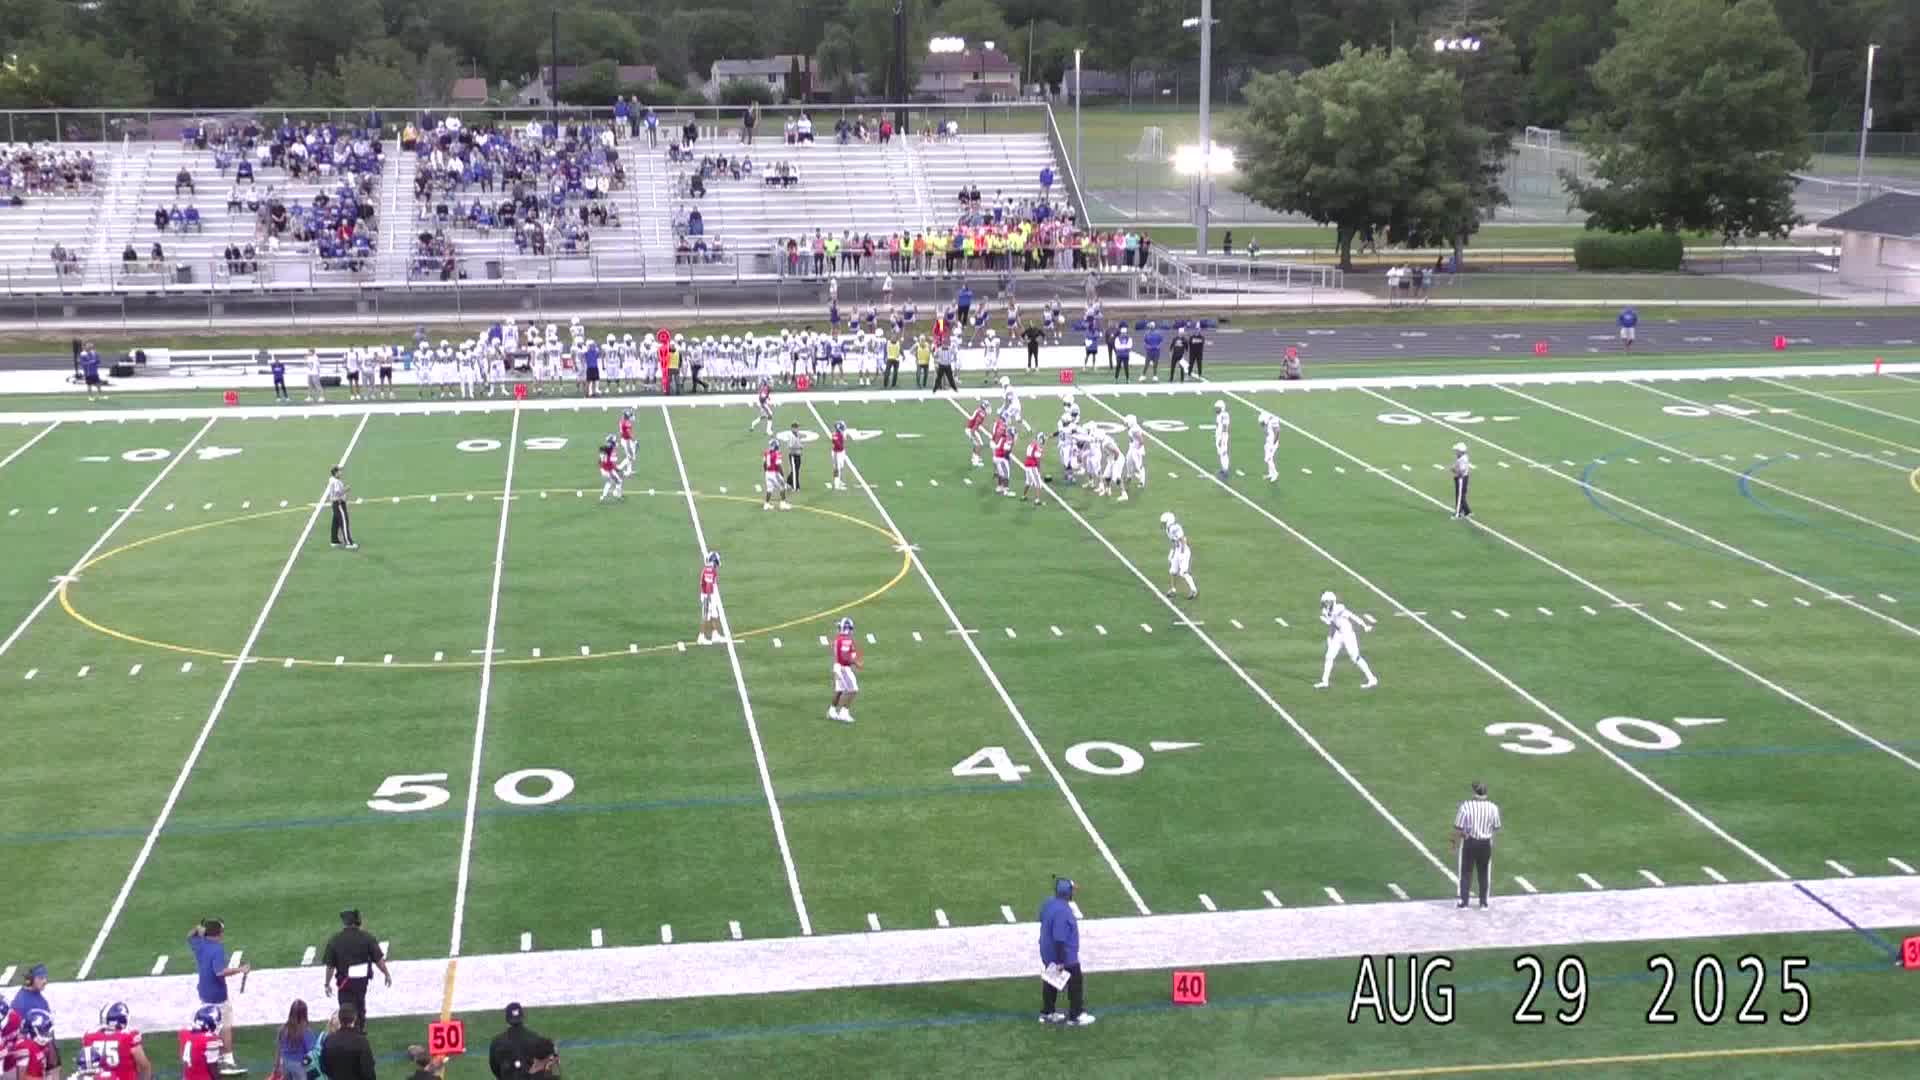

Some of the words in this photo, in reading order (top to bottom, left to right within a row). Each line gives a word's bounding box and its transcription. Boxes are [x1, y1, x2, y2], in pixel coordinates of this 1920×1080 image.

[1484, 716, 1682, 755] 30
[952, 741, 1144, 782] 40
[366, 769, 574, 812] 50
[1907, 941, 1920, 963] 3
[1176, 974, 1203, 998] 40
[433, 1025, 460, 1049] 50
